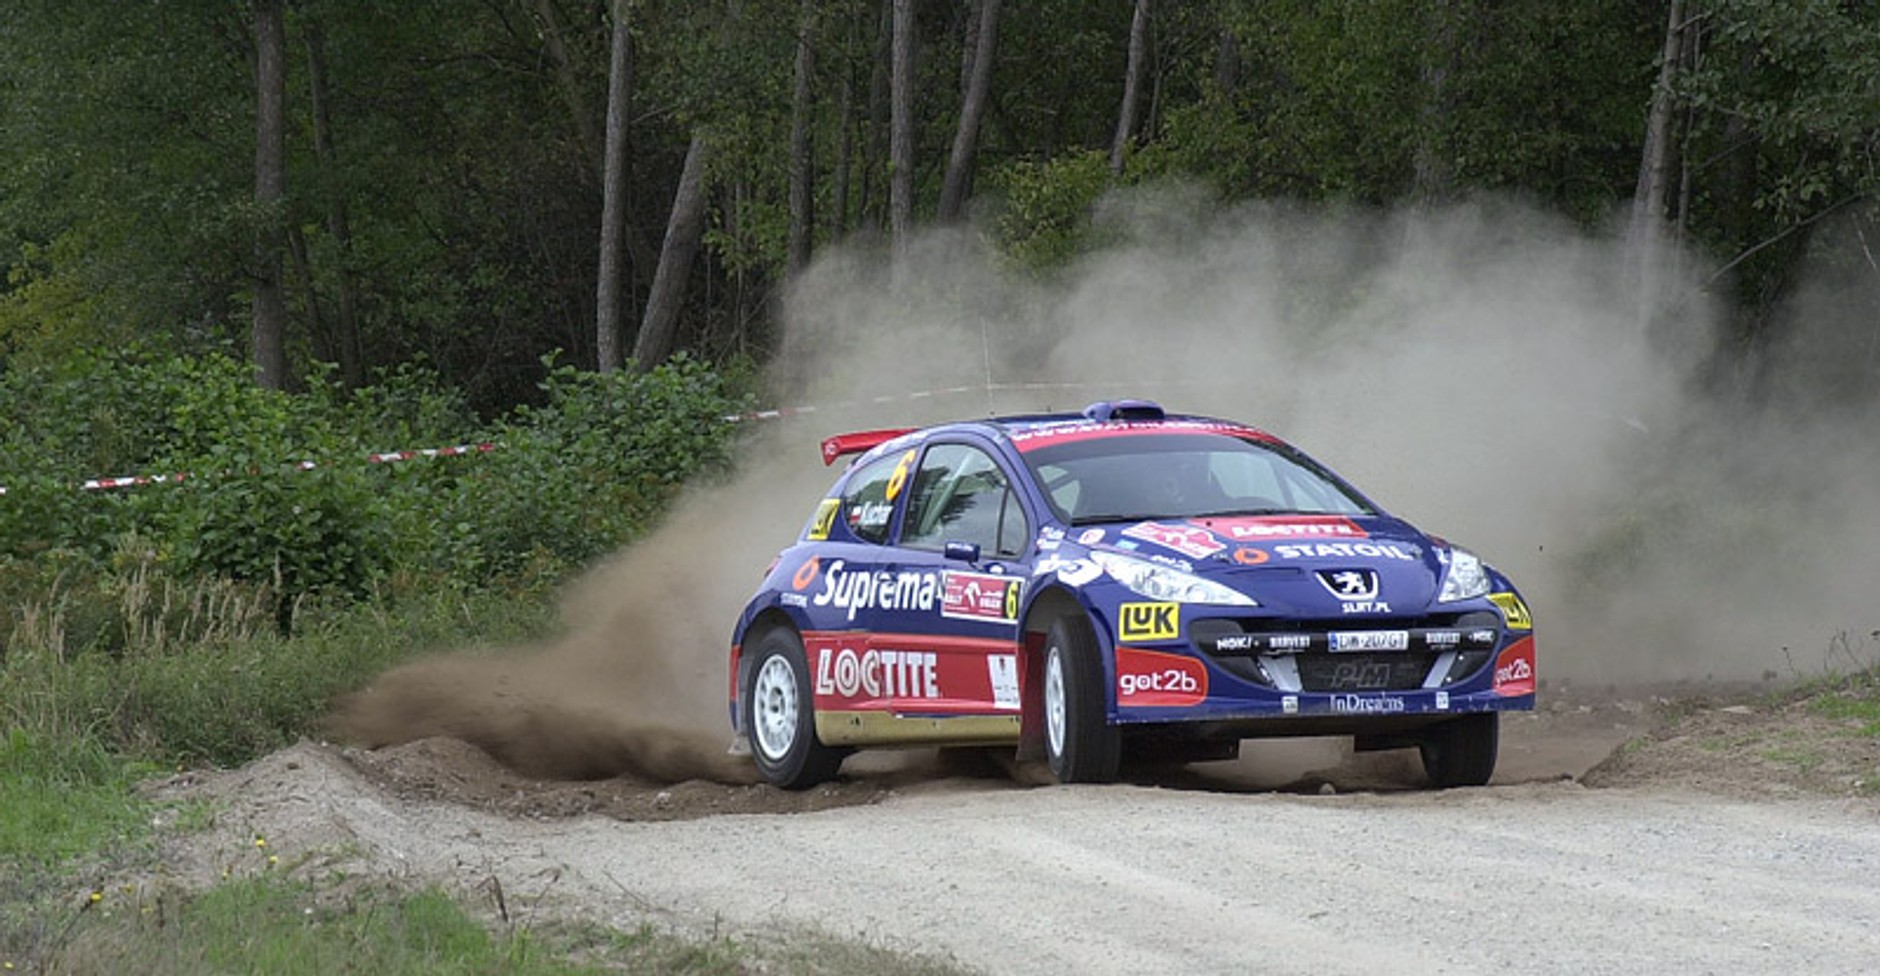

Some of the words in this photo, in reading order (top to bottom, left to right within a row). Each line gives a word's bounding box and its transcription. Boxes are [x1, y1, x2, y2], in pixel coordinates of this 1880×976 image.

[885, 449, 917, 500] 6
[1274, 542, 1413, 561] STATOIL
[813, 561, 937, 621] Suprema
[1006, 580, 1019, 620] 6
[815, 649, 939, 697] LOCTITE
[1120, 670, 1198, 695] got2b
